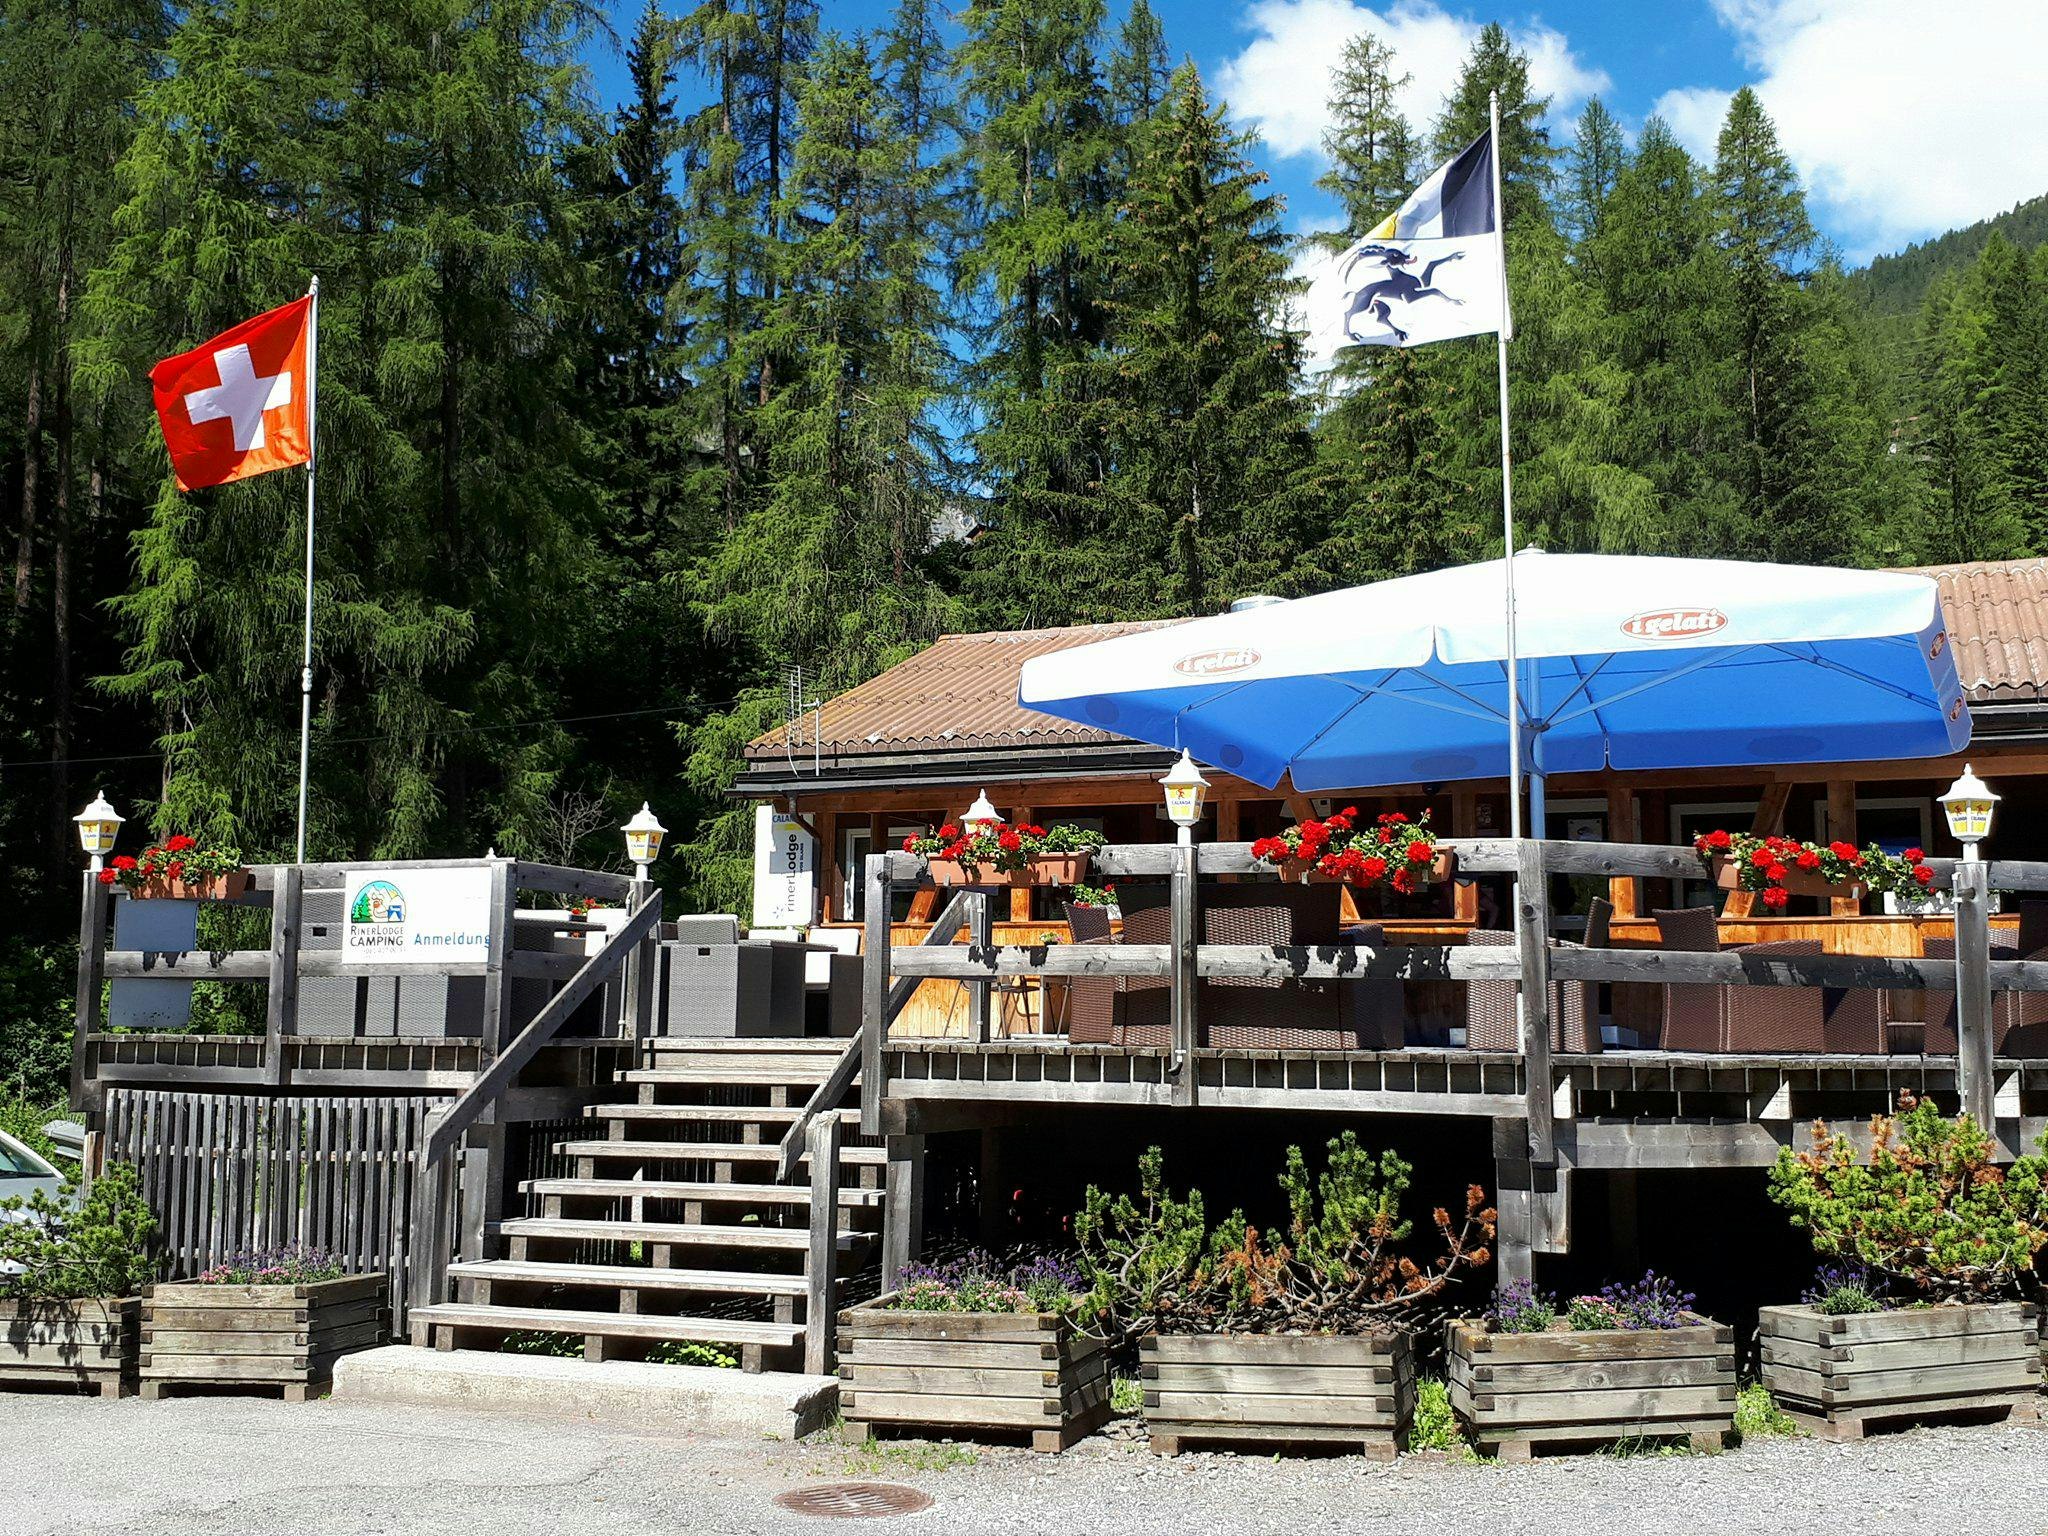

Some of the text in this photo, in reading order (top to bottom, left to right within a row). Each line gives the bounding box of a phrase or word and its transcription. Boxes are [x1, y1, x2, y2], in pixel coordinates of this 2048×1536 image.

[786, 833, 799, 912] rinerLodge
[350, 935, 404, 947] CAMPING
[414, 932, 491, 949] Anmeldung
